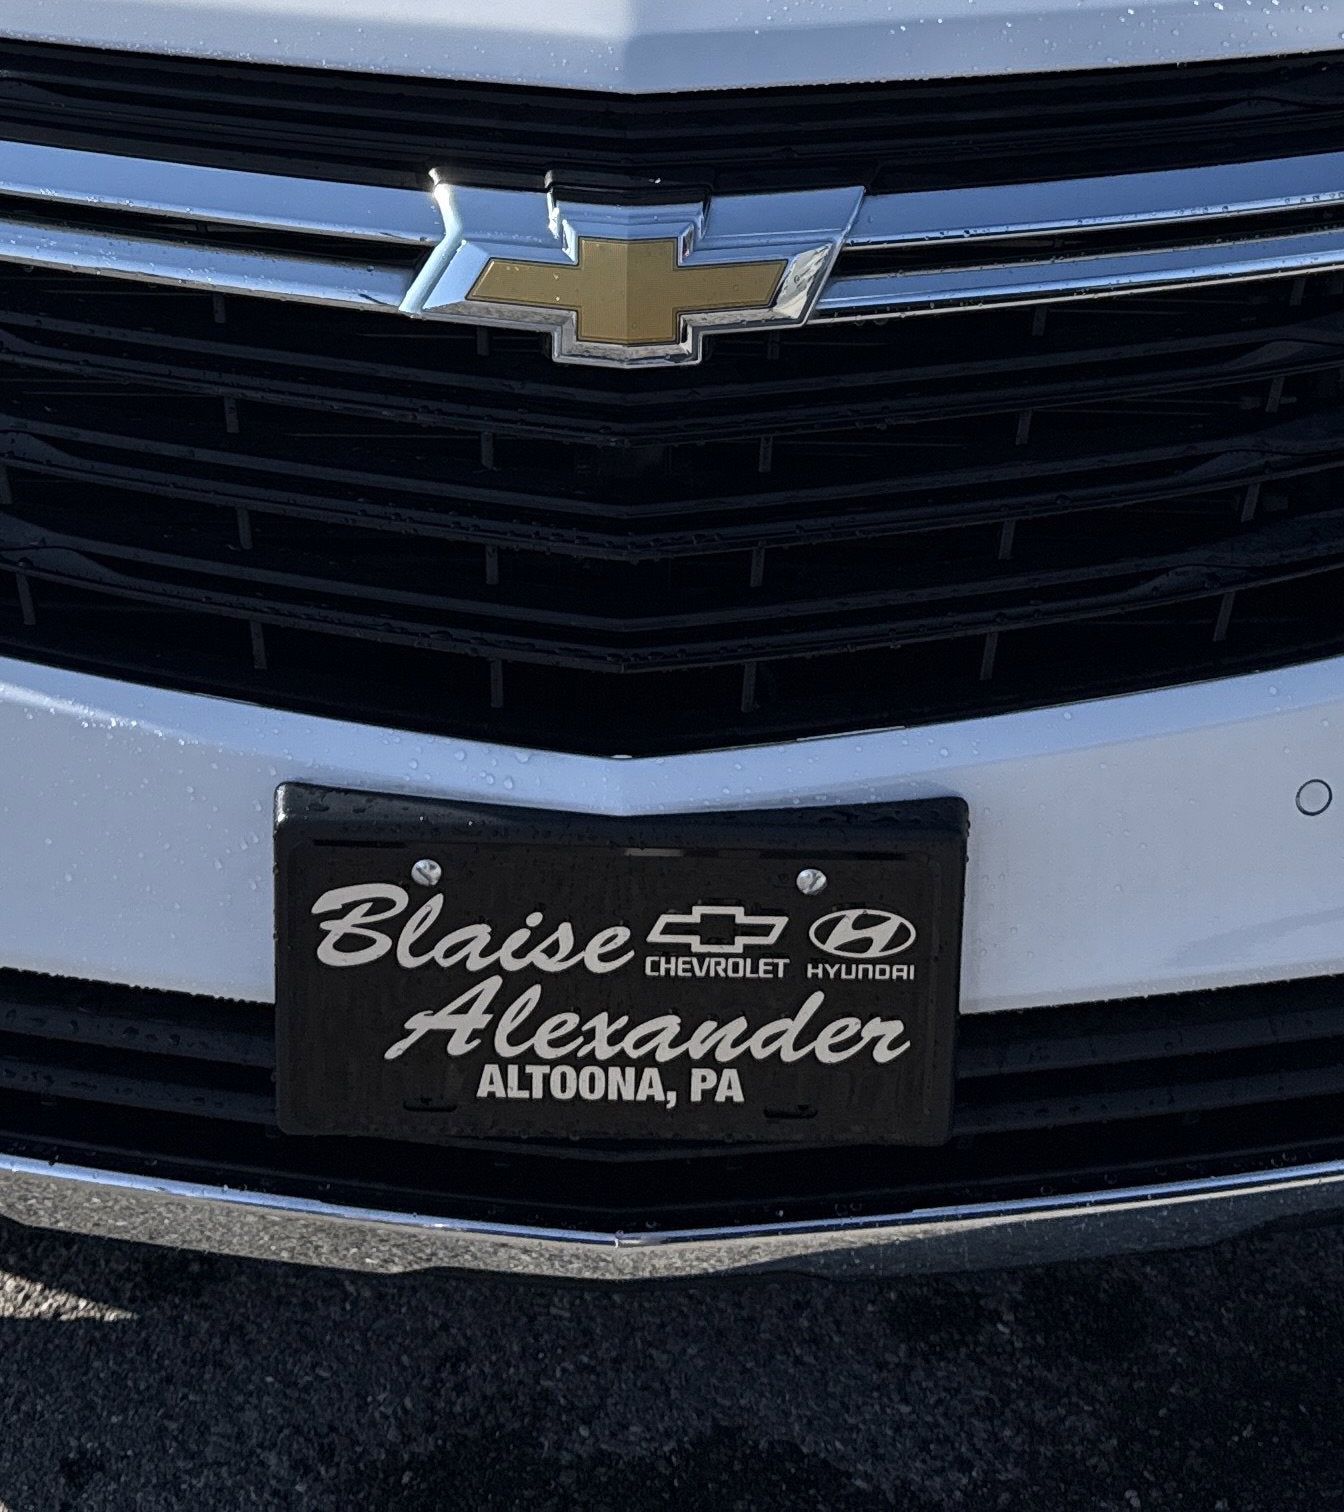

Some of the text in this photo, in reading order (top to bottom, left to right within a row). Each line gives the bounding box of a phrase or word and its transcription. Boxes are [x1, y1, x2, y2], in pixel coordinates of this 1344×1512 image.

[311, 882, 635, 974] Blaise
[644, 956, 790, 978] CHEVROLET
[806, 962, 916, 981] HYUNDAI
[384, 975, 911, 1064] Alexander
[476, 1063, 745, 1109] ALTOONA, PA
